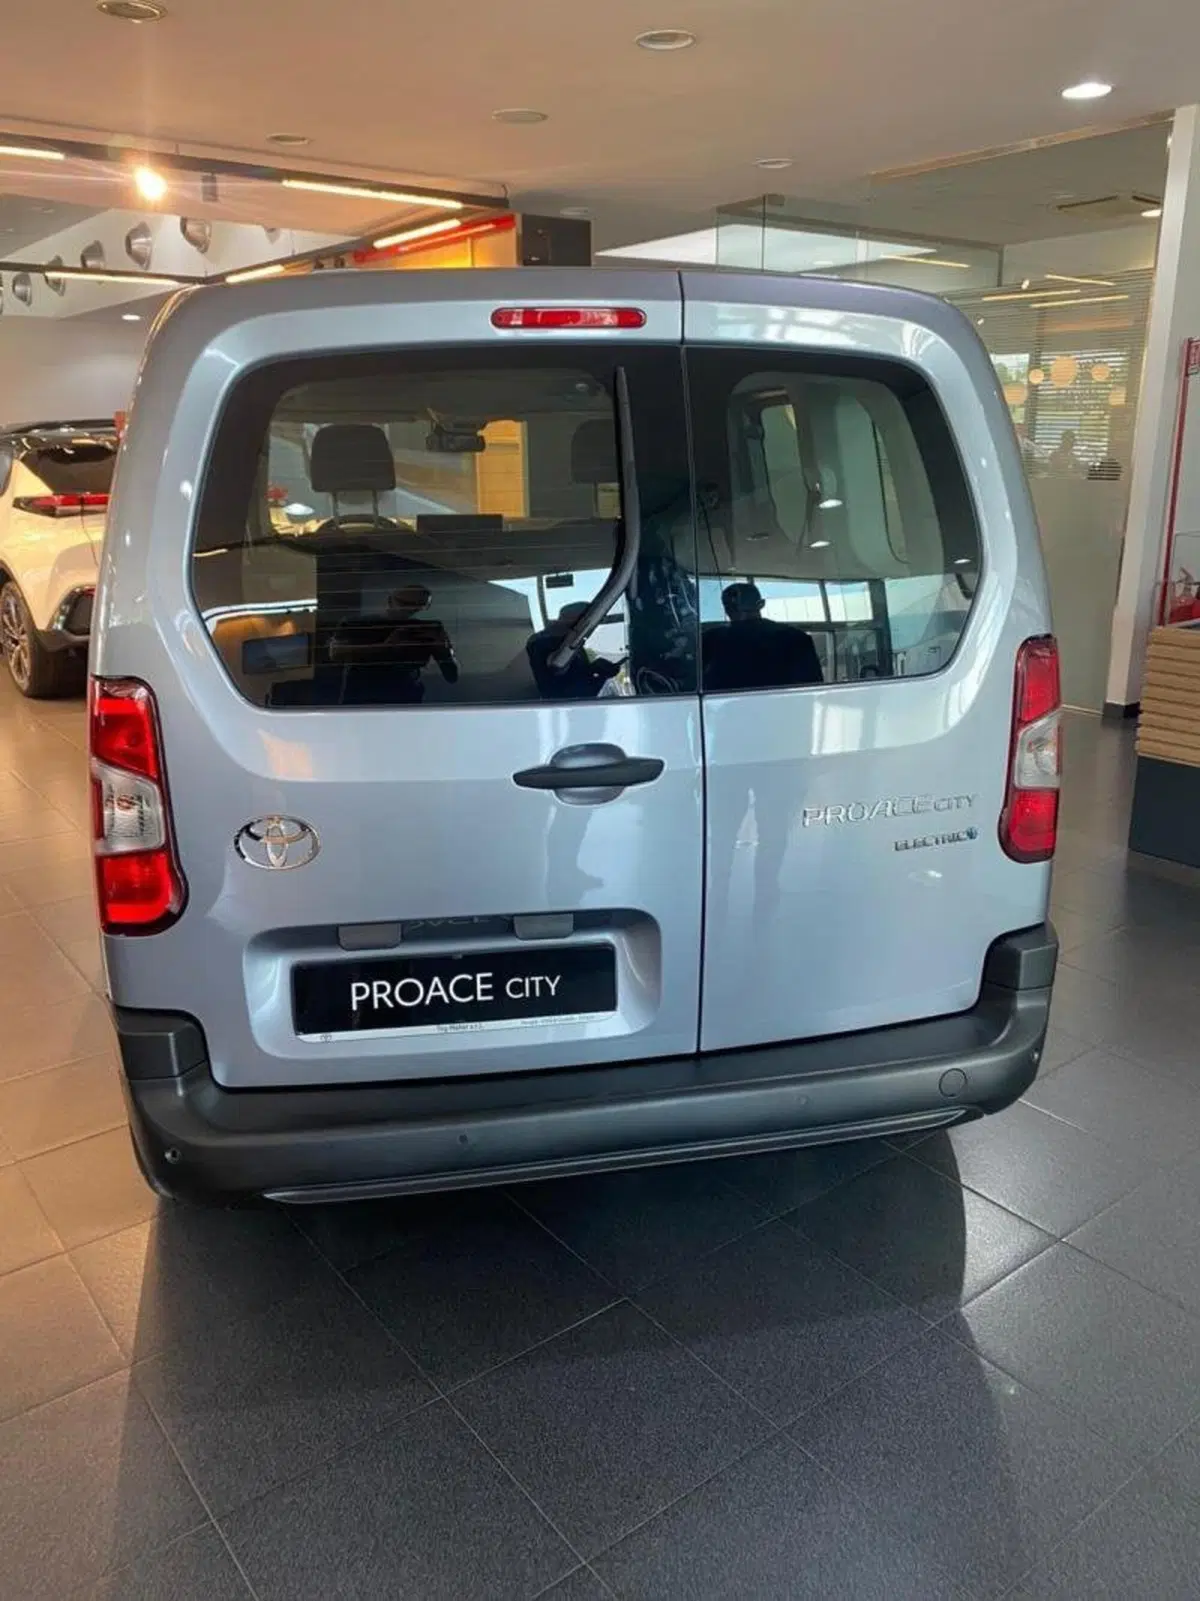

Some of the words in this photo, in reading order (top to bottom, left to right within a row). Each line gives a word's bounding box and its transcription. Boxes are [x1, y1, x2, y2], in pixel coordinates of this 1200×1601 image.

[802, 794, 932, 828] PROACE
[933, 793, 977, 813] CITY
[894, 829, 967, 852] ELECTRIC
[351, 972, 494, 1011] PROACE
[505, 975, 561, 999] CITY
